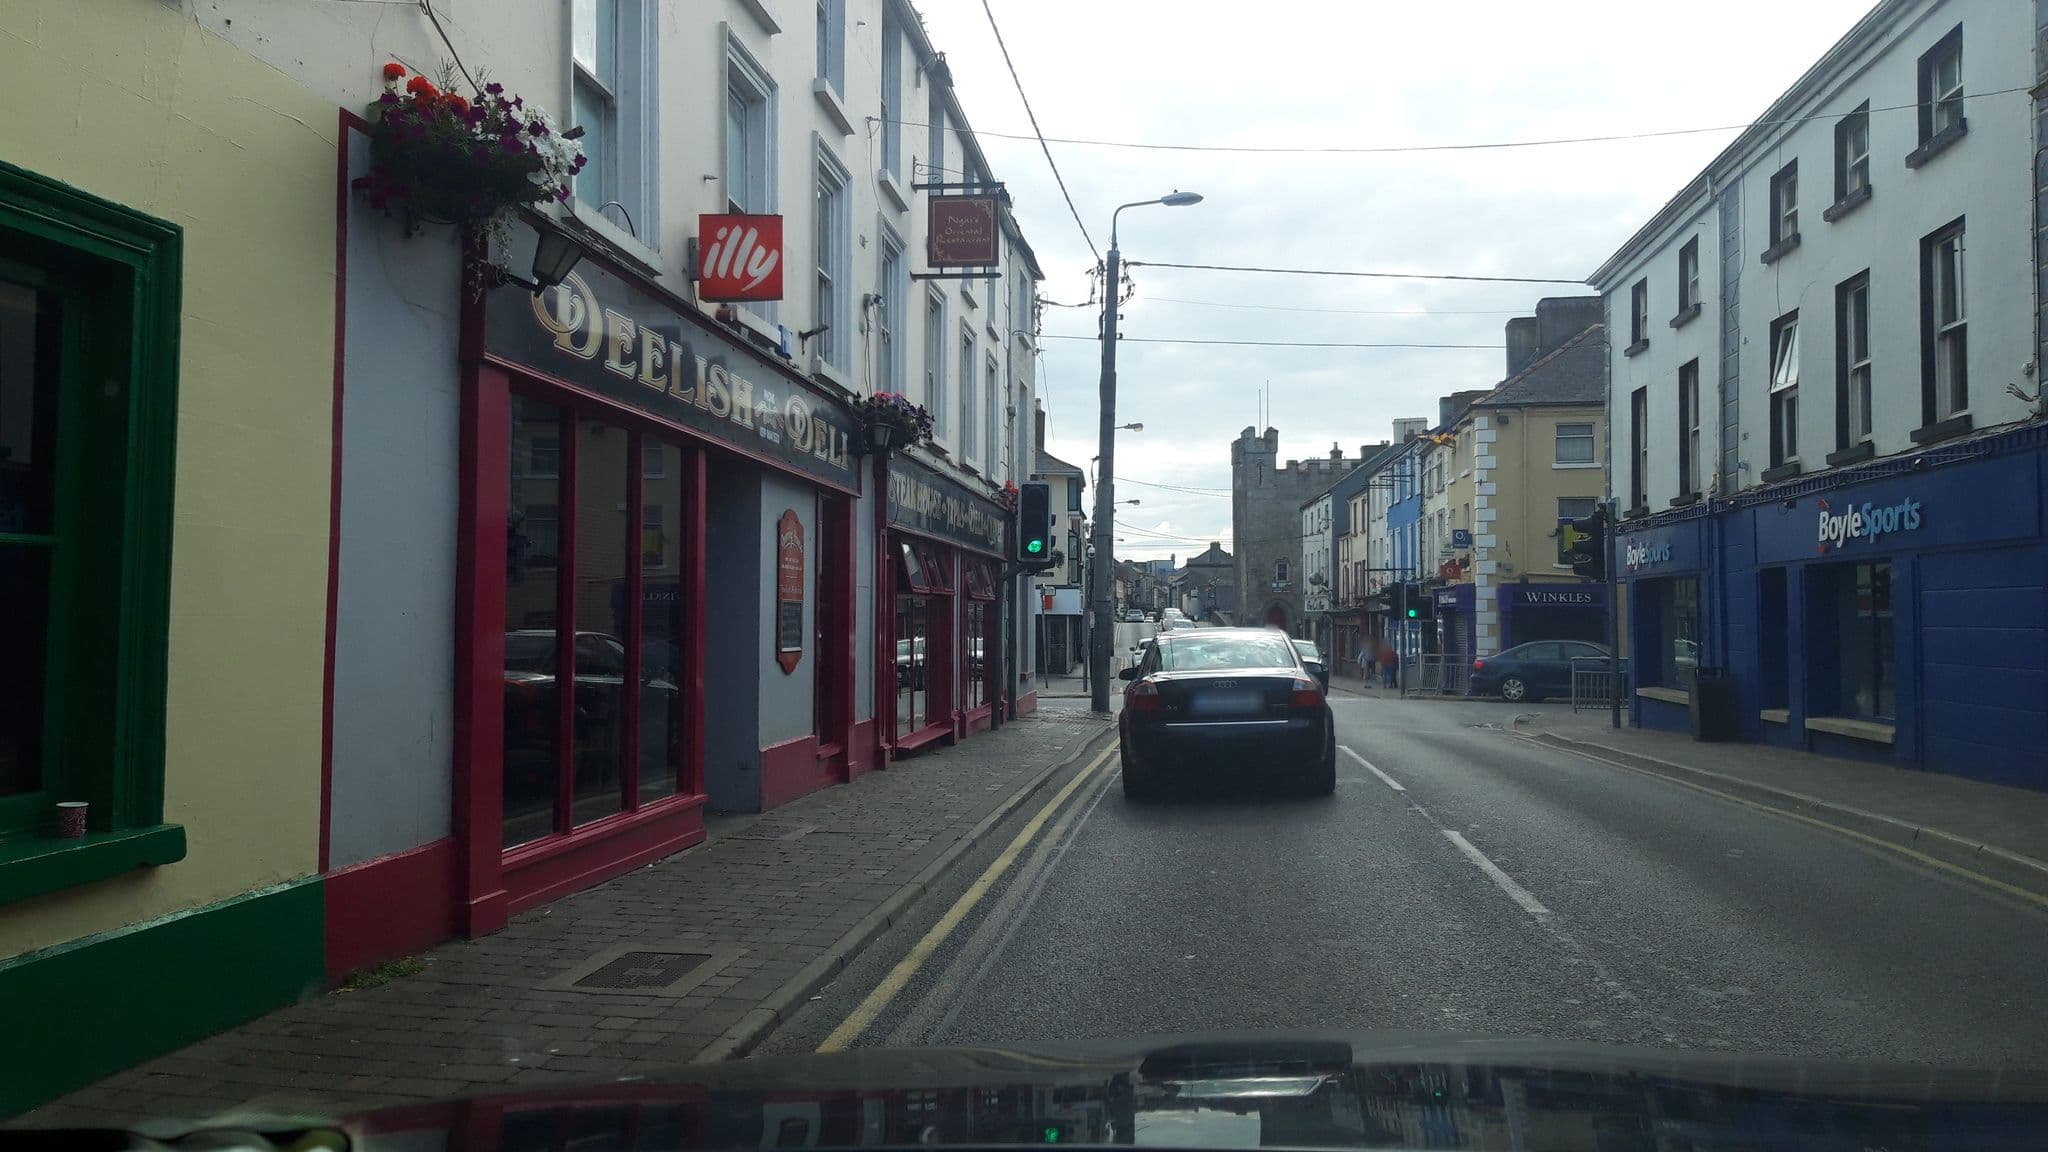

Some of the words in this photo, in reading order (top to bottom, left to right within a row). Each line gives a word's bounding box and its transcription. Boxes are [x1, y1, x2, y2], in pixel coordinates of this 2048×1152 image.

[703, 225, 779, 292] illy
[1818, 497, 1920, 548] BoyleSports
[1626, 542, 1671, 570] BoyleSports
[1526, 591, 1592, 603] WINKLES
